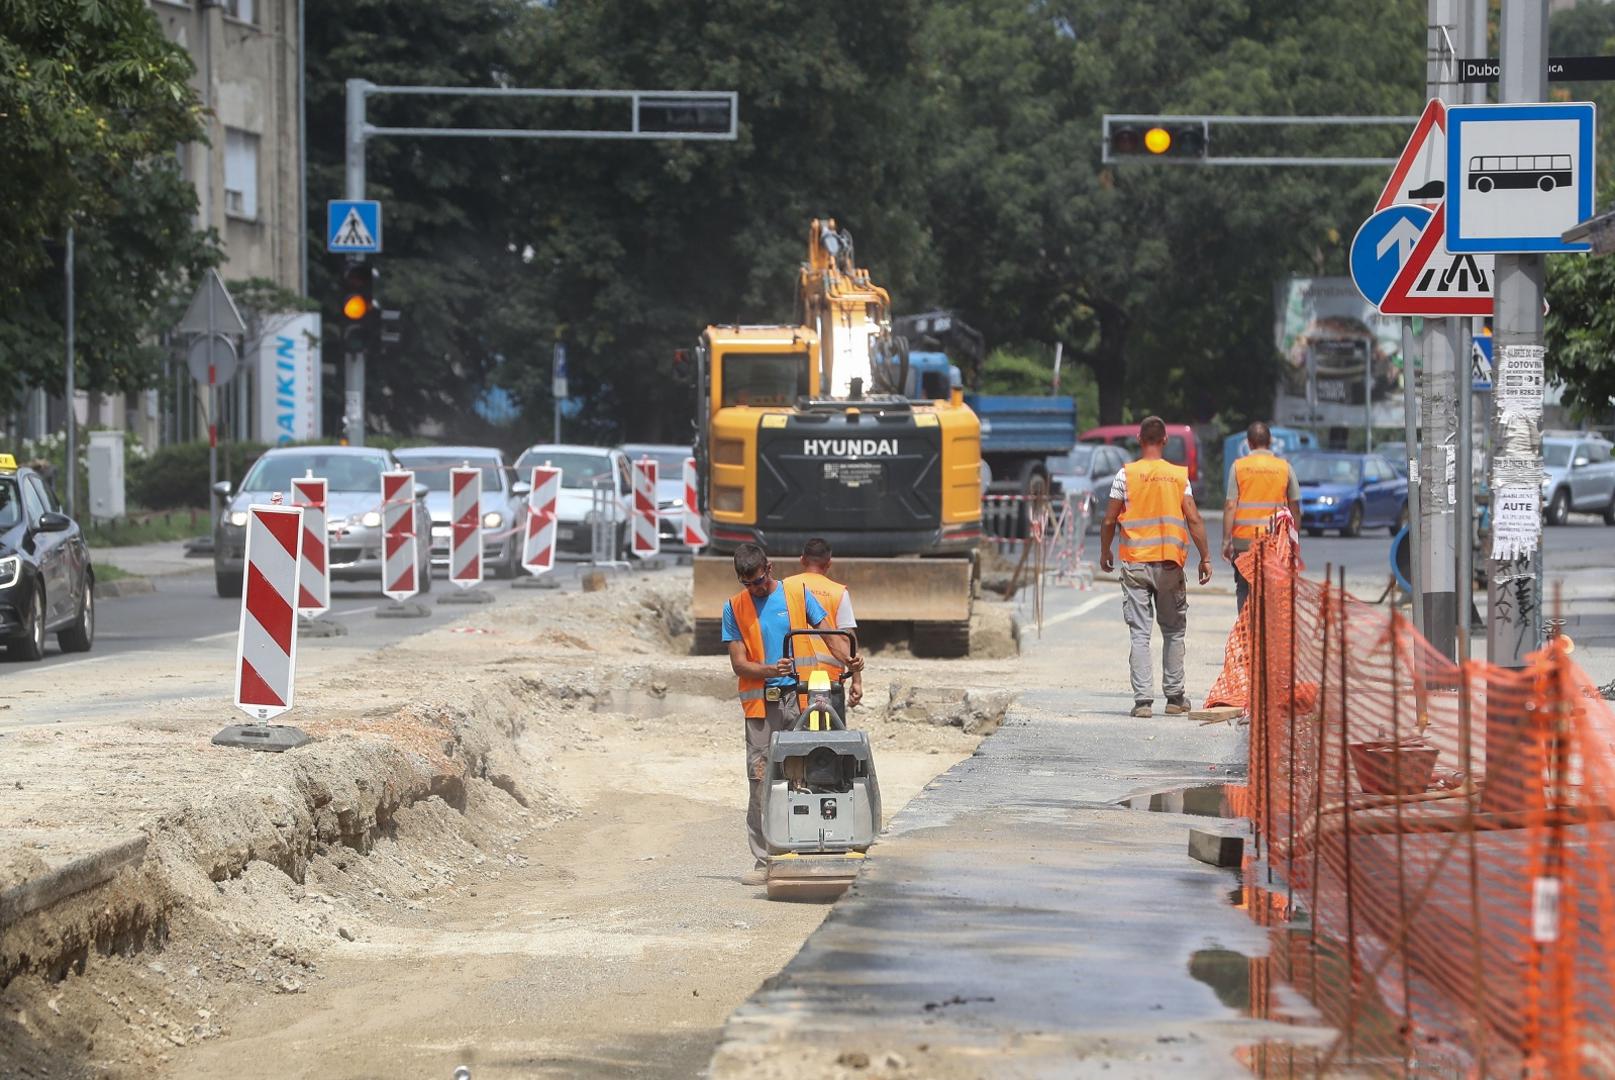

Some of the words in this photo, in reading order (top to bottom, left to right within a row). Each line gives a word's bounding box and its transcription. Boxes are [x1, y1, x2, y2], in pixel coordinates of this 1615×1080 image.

[1467, 63, 1500, 76] Dubo
[1548, 64, 1564, 73] ICA
[803, 439, 899, 456] HYUNDAI
[1502, 502, 1533, 511] AUTE
